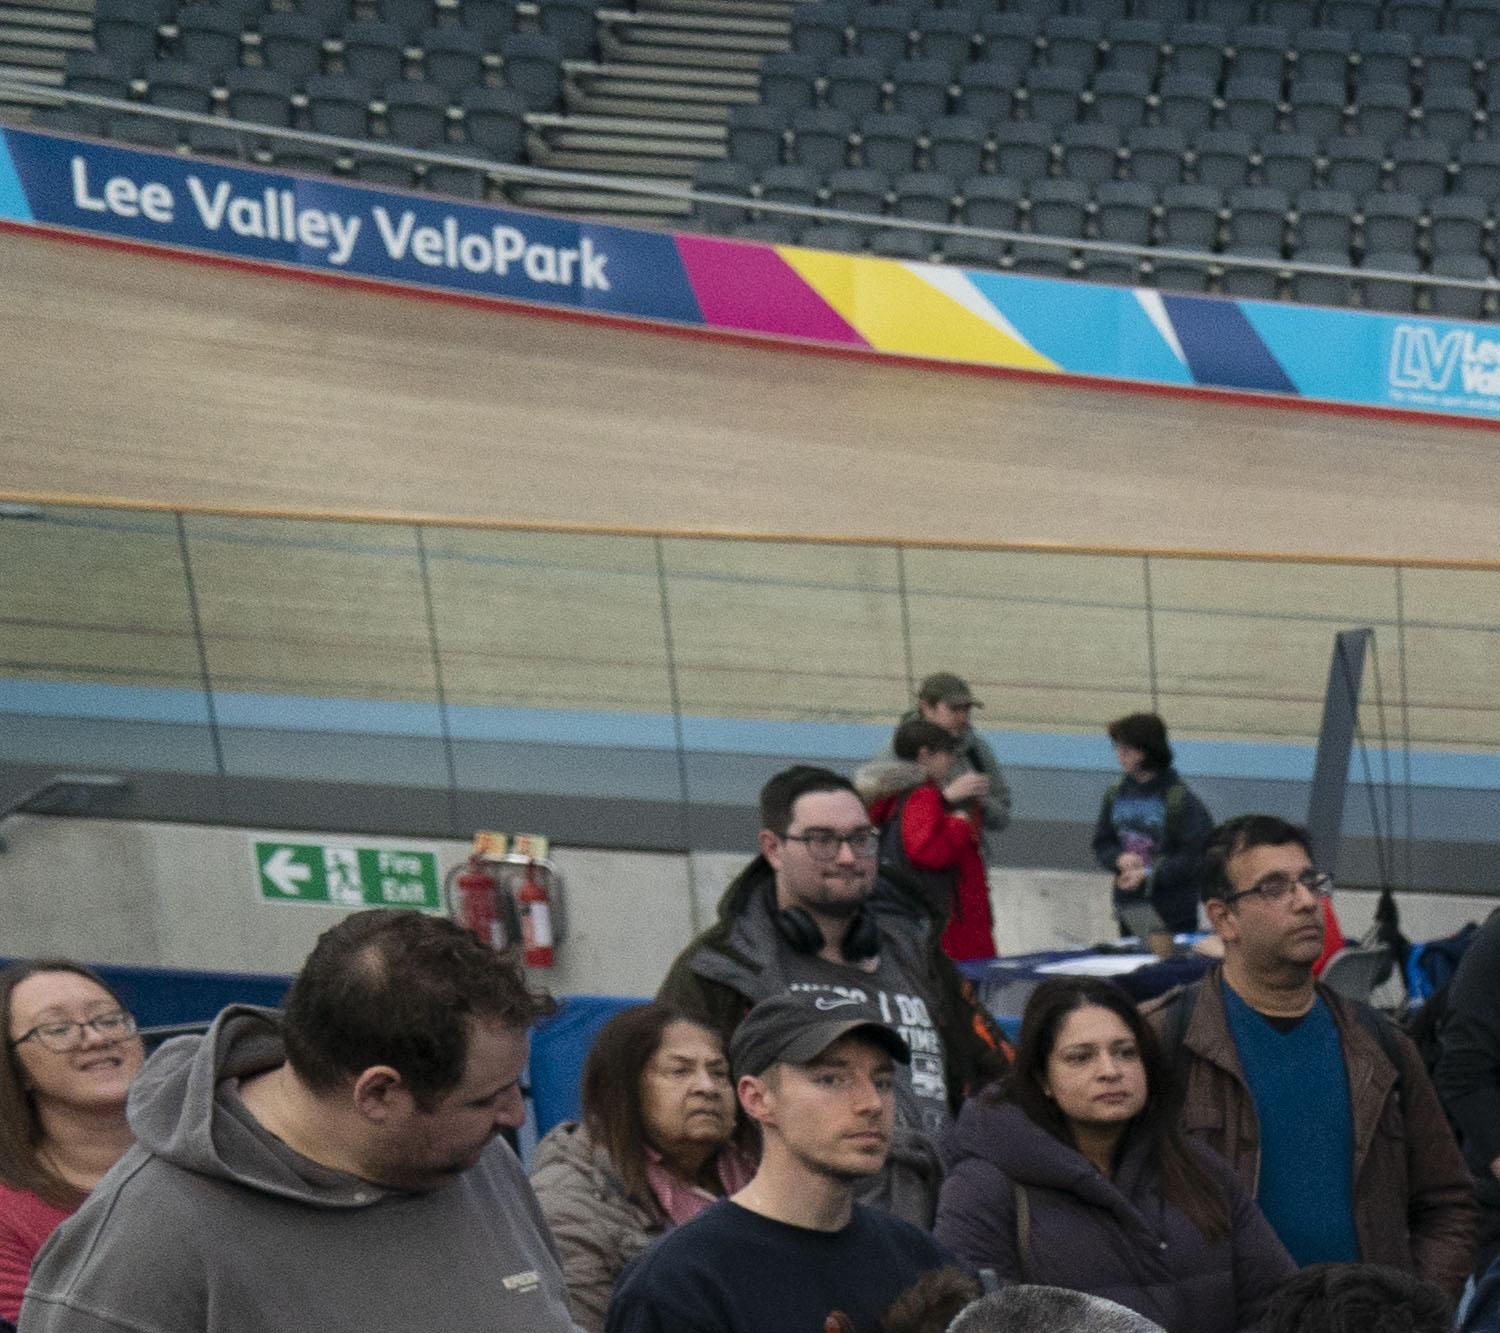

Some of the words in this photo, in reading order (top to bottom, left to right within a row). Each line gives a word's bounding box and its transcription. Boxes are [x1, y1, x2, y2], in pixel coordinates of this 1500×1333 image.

[70, 155, 174, 223] Lee
[186, 175, 363, 265] Valley
[372, 206, 611, 290] VeloPark
[377, 851, 423, 876] Fire
[380, 876, 427, 903] Exit
